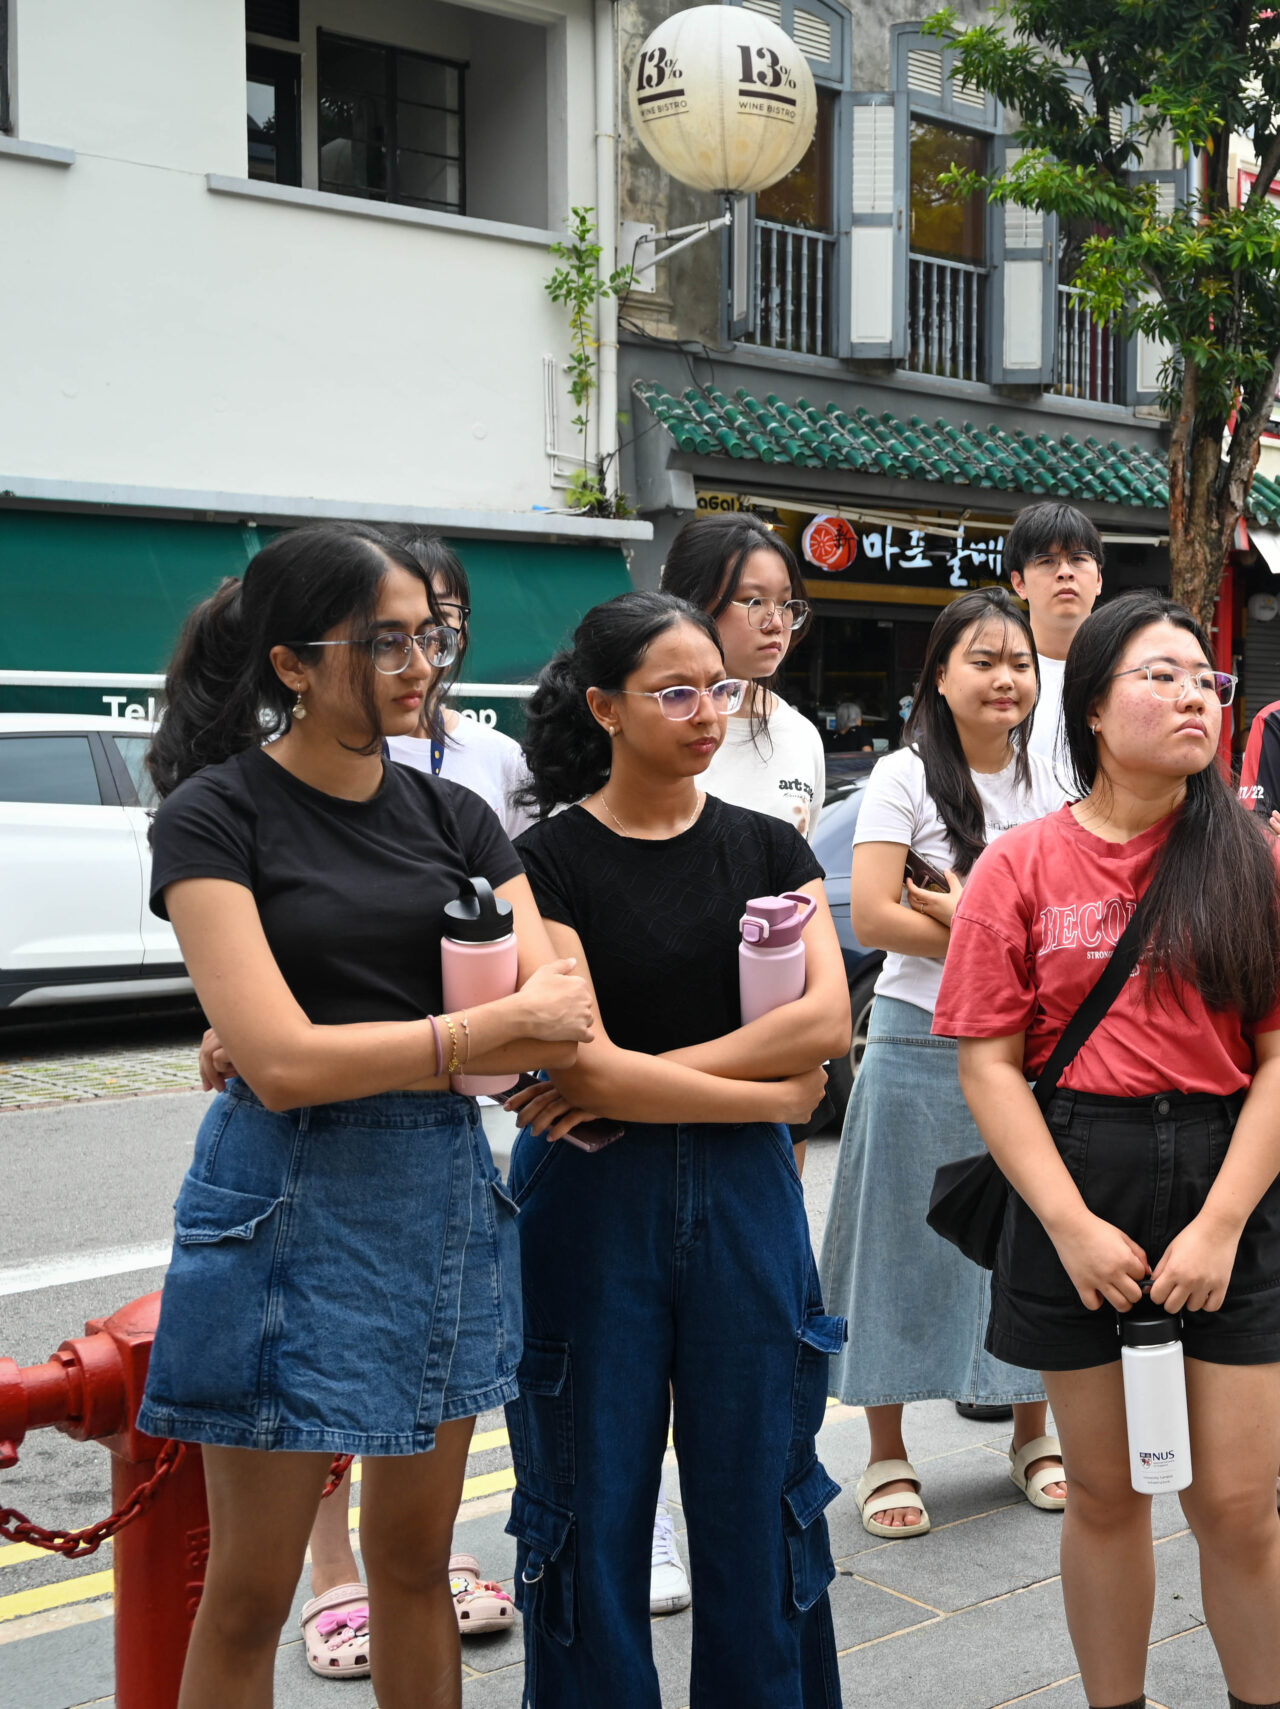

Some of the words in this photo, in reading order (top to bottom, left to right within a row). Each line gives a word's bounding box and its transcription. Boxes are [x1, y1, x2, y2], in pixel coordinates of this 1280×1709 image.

[636, 47, 683, 92] 13%
[736, 44, 797, 89] 13%
[657, 100, 688, 114] BISTRO
[738, 101, 765, 111] WINE
[766, 104, 797, 120] BISTRO
[1152, 1450, 1175, 1461] NUS
